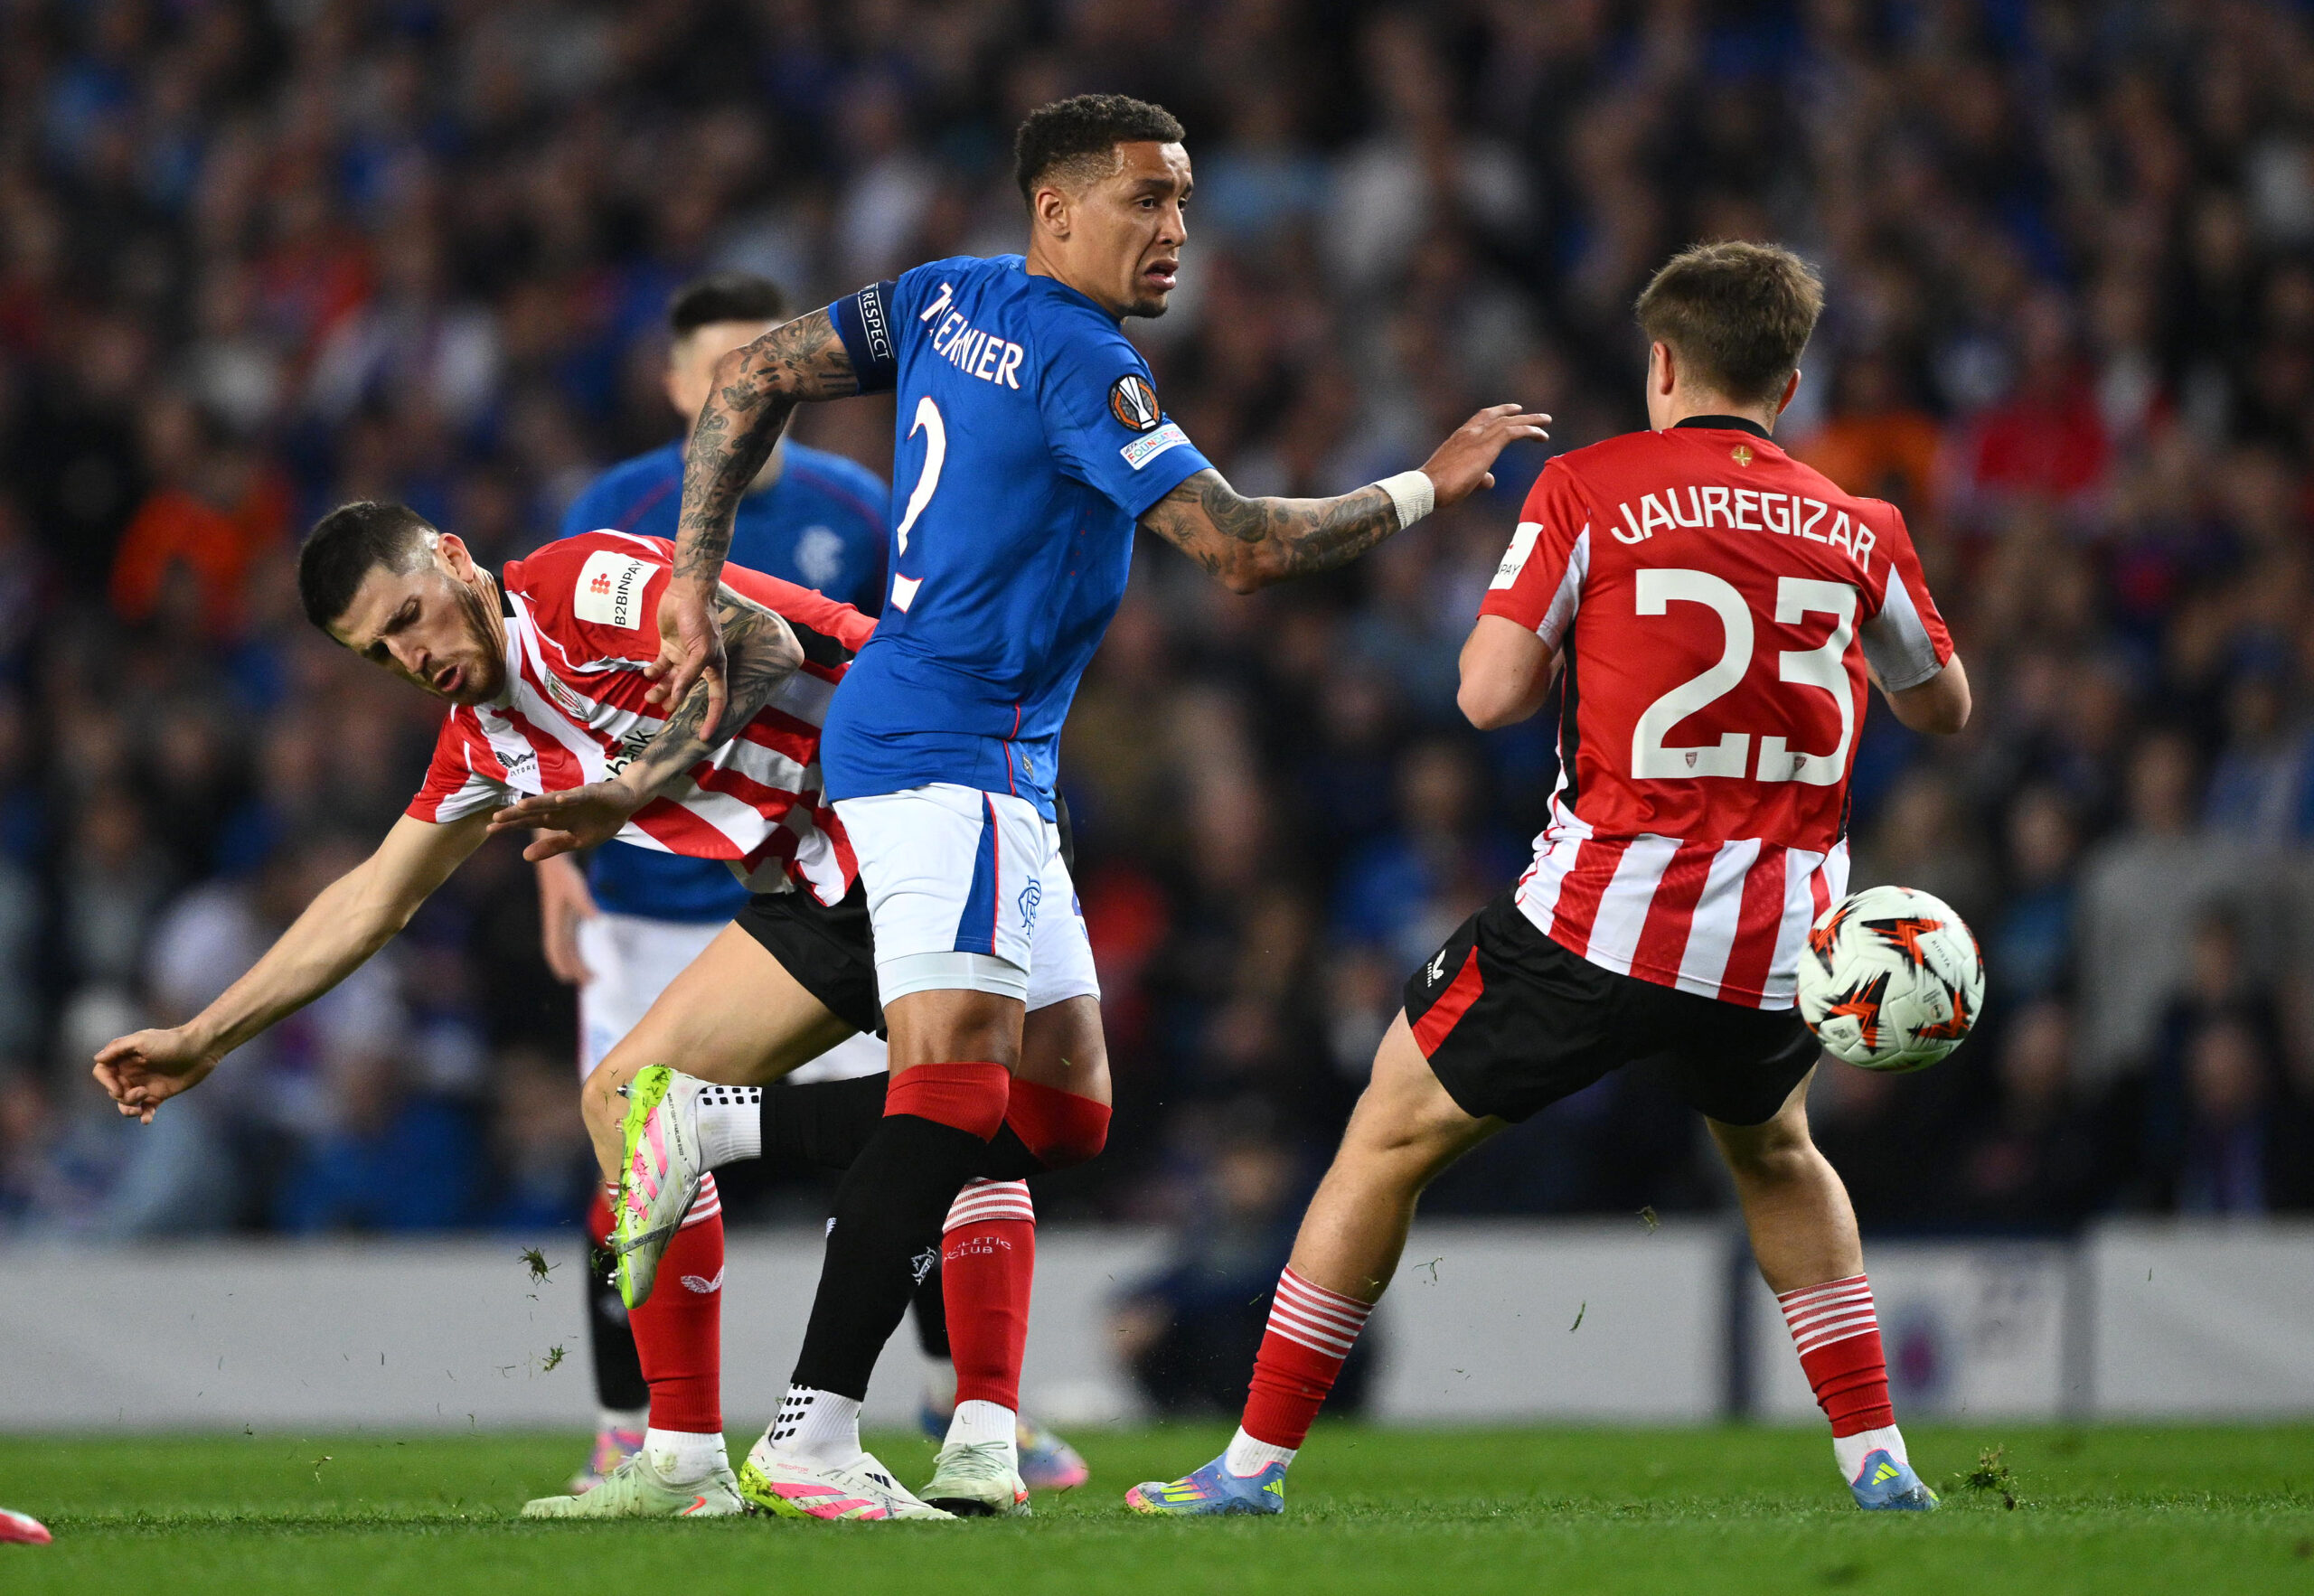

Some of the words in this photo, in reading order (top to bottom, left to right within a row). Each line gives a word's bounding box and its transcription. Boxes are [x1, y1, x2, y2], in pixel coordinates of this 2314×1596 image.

[862, 292, 889, 359] RESPECT
[920, 282, 1024, 390] TENIER
[1611, 485, 1877, 572] JAUREGIZAR
[615, 560, 644, 625] B2BINPAY
[1632, 568, 1858, 786] 23
[946, 1236, 1011, 1255] LETIC
[947, 1246, 993, 1259] CLUB
